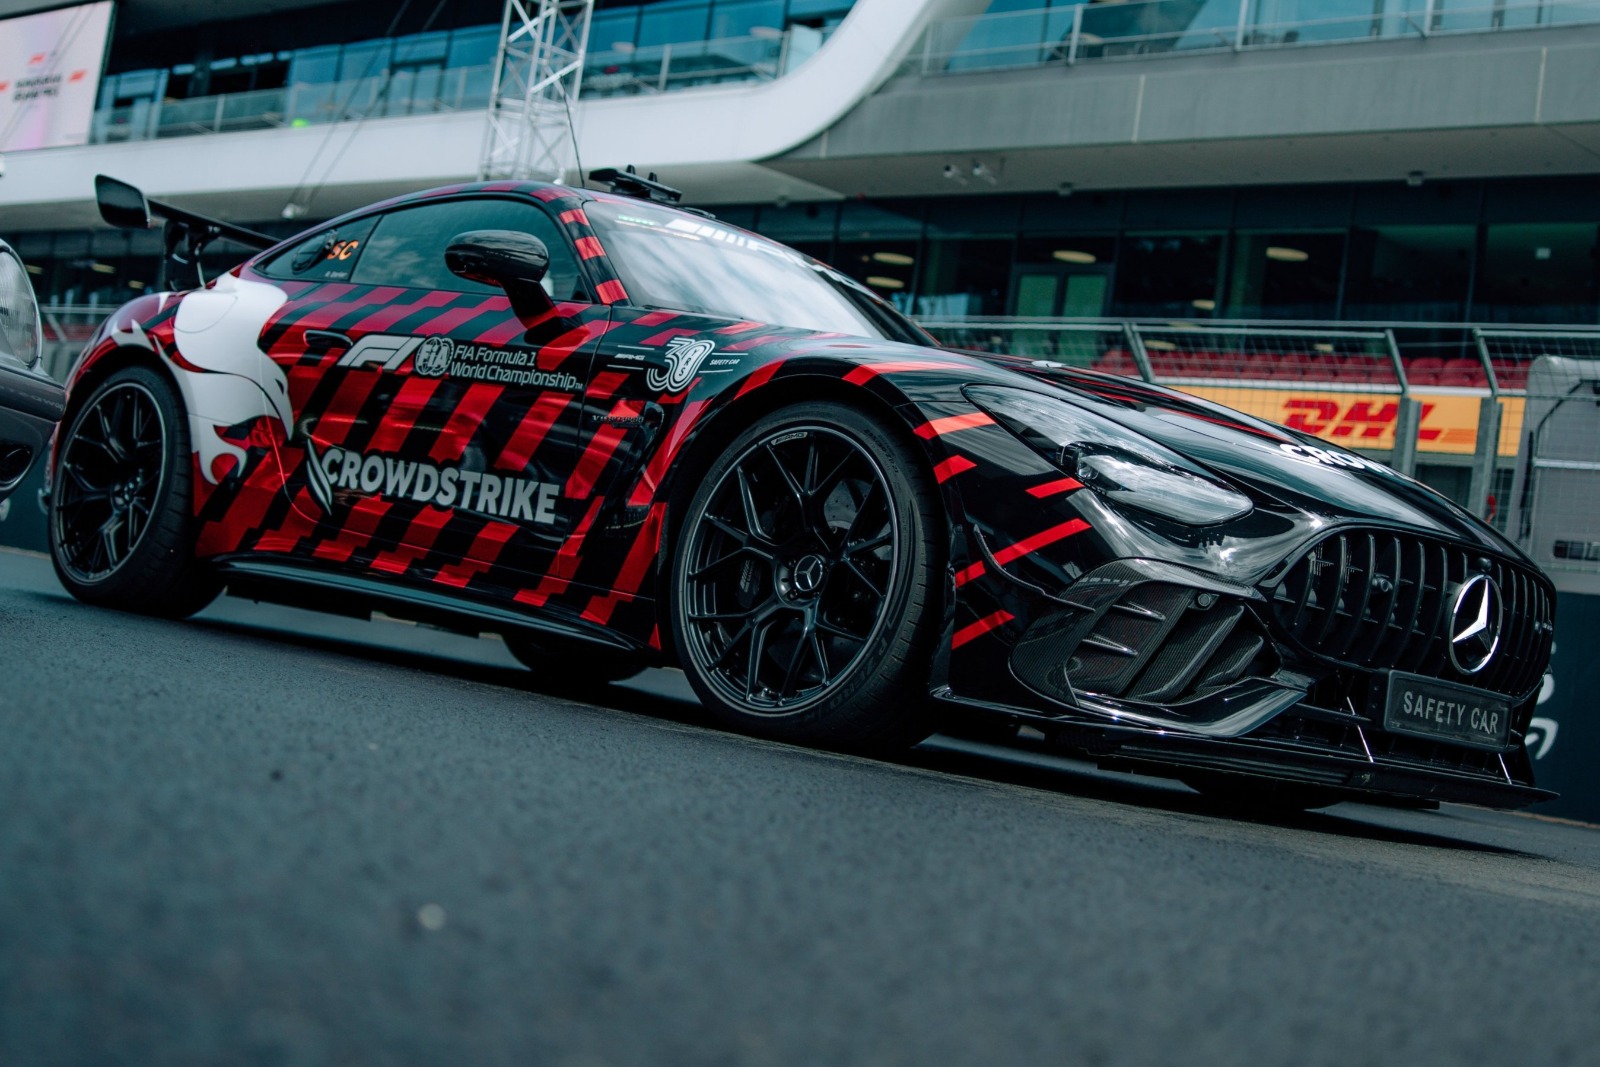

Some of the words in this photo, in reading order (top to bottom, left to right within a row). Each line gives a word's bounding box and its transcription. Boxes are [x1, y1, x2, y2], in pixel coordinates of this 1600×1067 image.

[326, 240, 359, 260] SC
[336, 334, 426, 370] F1
[450, 361, 488, 379] World
[453, 344, 475, 361] FIA
[475, 346, 528, 366] Formula
[526, 351, 537, 367] 1
[646, 337, 716, 392] 30
[709, 358, 730, 366] SAFETY
[1282, 399, 1443, 440] DHL
[321, 448, 560, 525] CROWDSTRIKE
[1403, 691, 1466, 726] SAFETY
[1470, 707, 1499, 735] CAR
